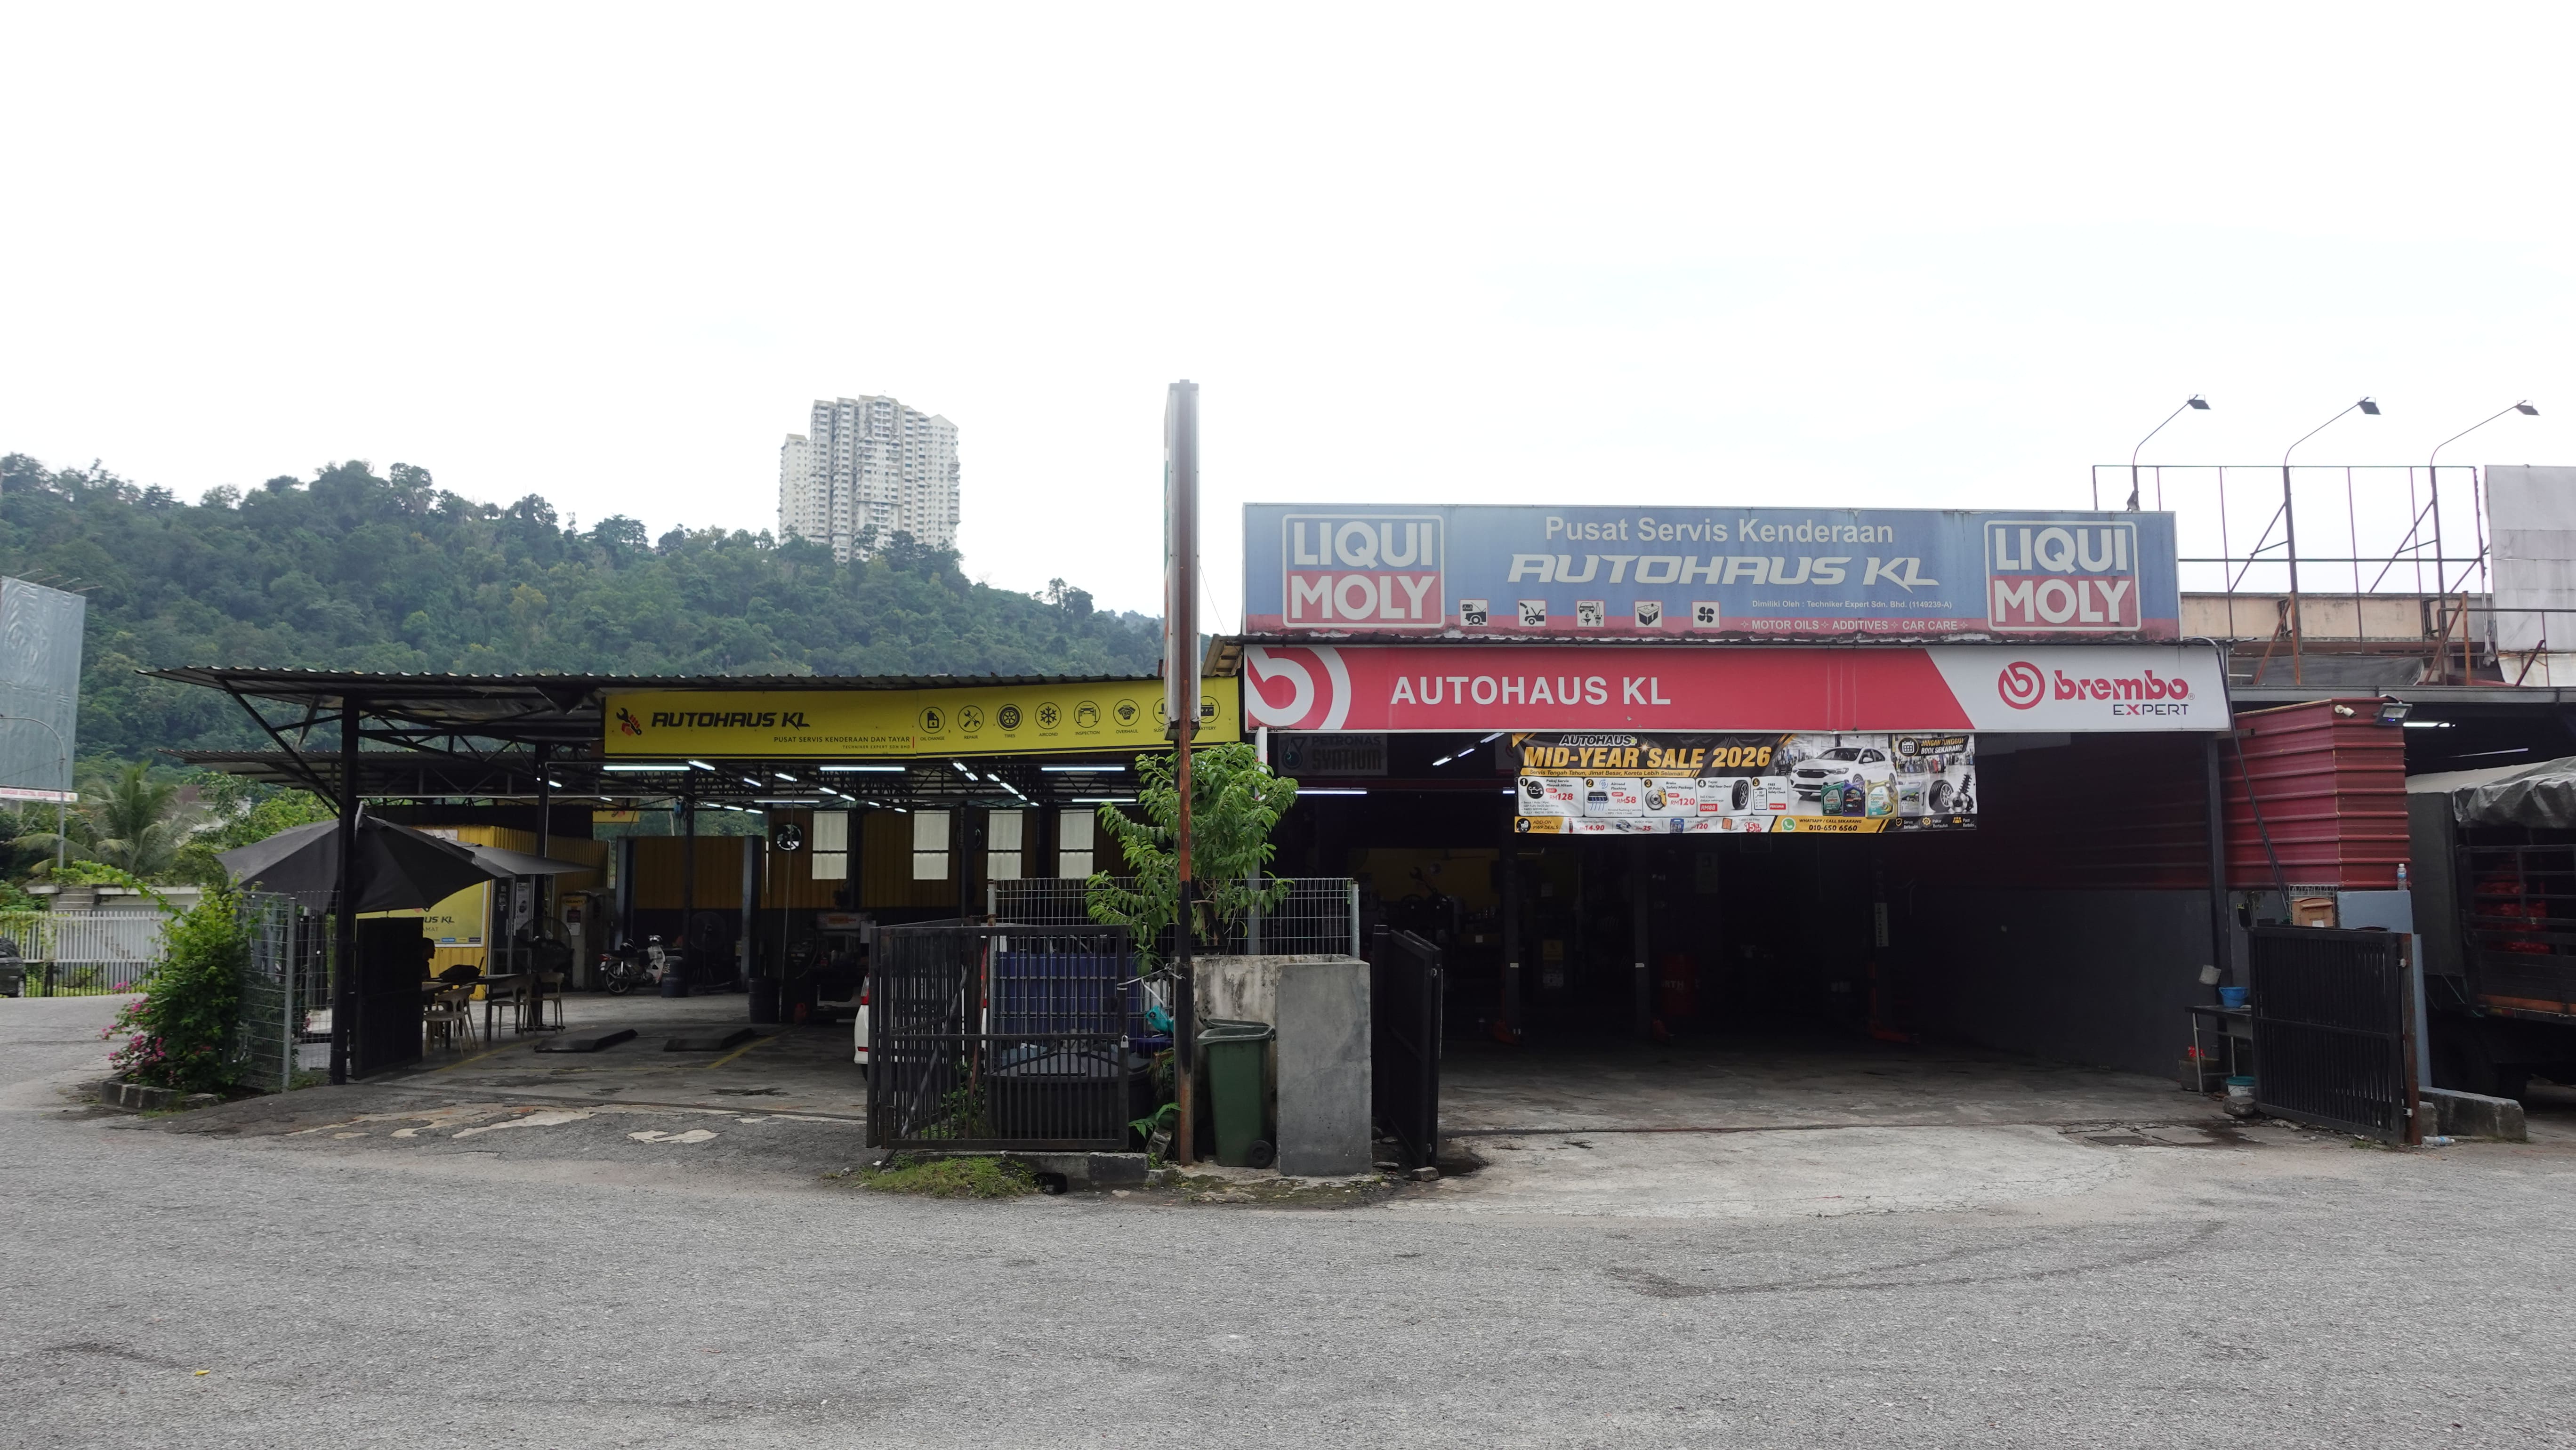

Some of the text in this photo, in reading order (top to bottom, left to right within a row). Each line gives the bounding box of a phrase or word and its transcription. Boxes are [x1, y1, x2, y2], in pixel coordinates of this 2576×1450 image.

[1546, 516, 1893, 543] Pusat Servis Kenderaan
[1294, 521, 1433, 569] LIQUI
[1995, 527, 2127, 574] LIQUI
[1507, 554, 1940, 594] AUTOHAUS KL
[1291, 574, 1436, 620] MOLY
[1844, 601, 1869, 609] Expert
[1909, 601, 1952, 609] (1149239-A)
[1994, 579, 2131, 624] MOLY
[1752, 620, 1958, 630] MOTOR OILS ADDITIVES CAR CARE
[1390, 675, 1671, 707] AUTOHAUS KL
[2054, 669, 2189, 700] brembo
[651, 712, 811, 731] AUTOHAUS KL
[2113, 704, 2189, 716] EXPERT
[1312, 735, 1382, 746] PETRONAS
[1523, 746, 1772, 768] MID-YEAR SALE 2026
[441, 916, 455, 924] KL
